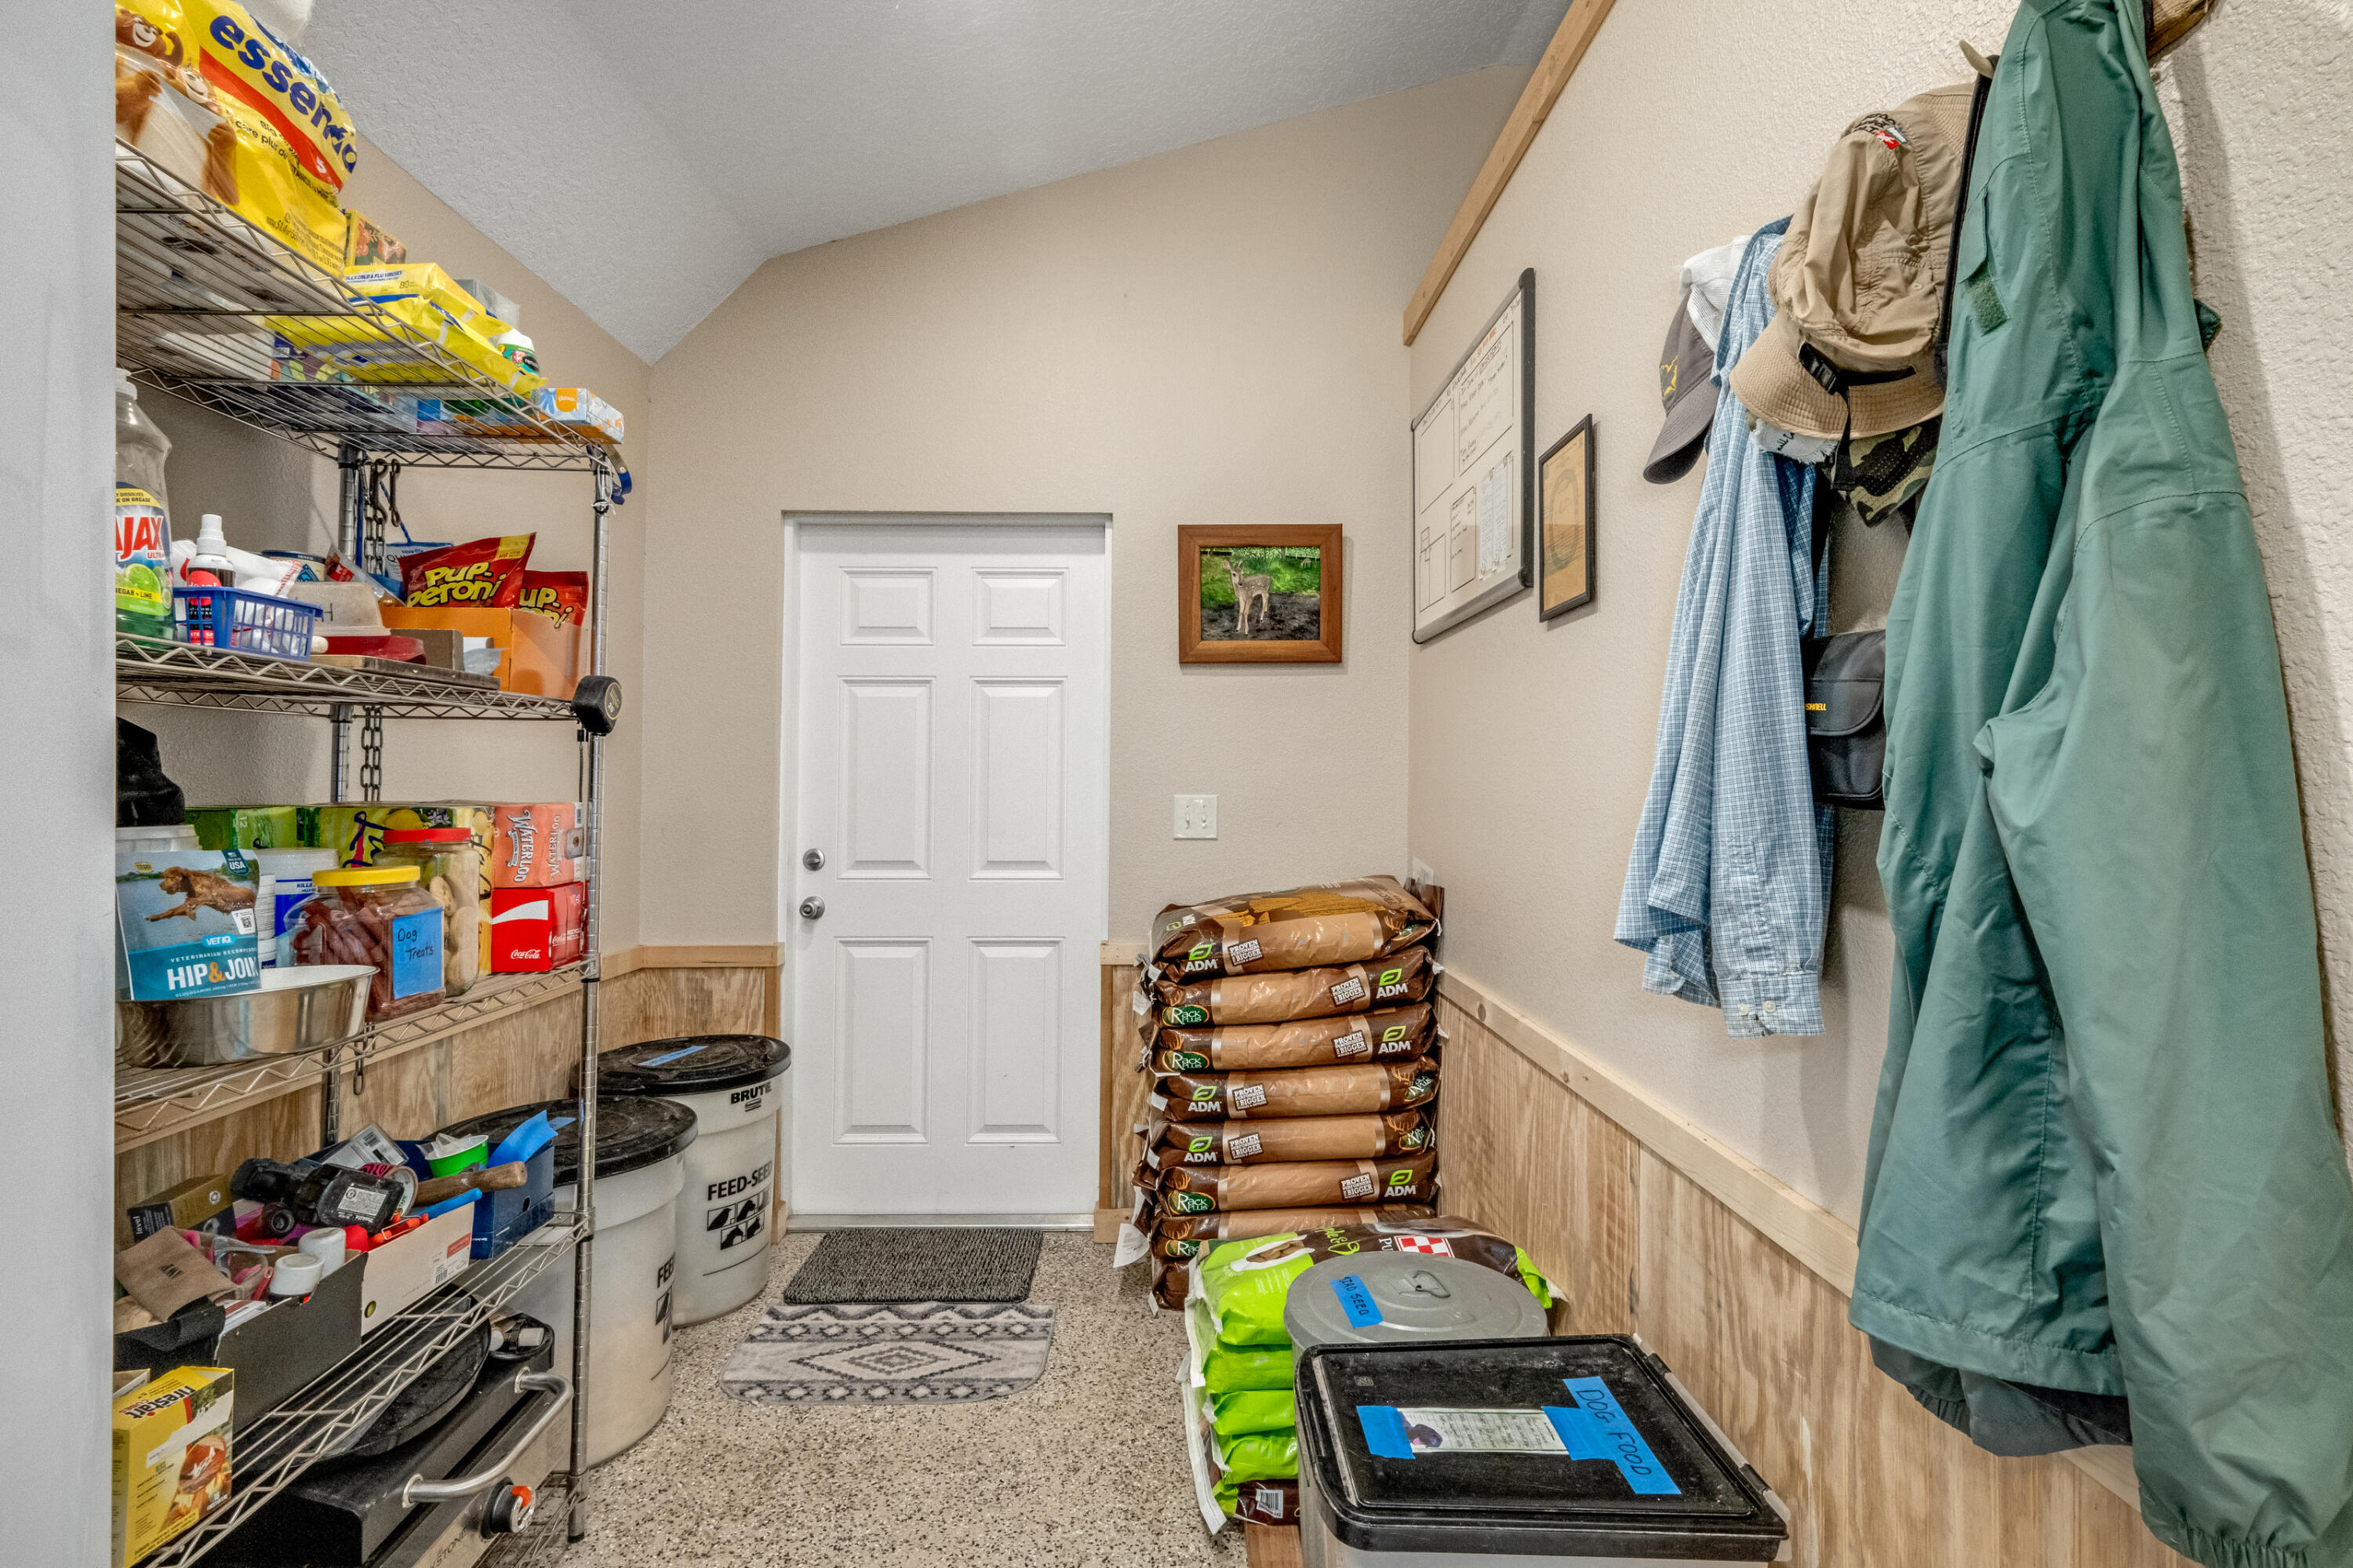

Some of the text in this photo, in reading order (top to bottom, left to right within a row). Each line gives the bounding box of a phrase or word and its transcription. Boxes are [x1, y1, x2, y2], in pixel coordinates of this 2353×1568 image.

[1805, 702, 1827, 711] SHNELL
[508, 809, 538, 883] WATERLOO
[228, 860, 246, 871] USA
[405, 944, 435, 961] Treats
[1229, 939, 1259, 952] PROVEN
[1236, 948, 1262, 962] BIGGER
[1184, 959, 1218, 973] ADM
[166, 963, 209, 991] HIP
[225, 956, 260, 981] JOIN
[1331, 977, 1360, 991] PROVEN
[1376, 983, 1409, 999] ADM
[1338, 988, 1364, 1002] BIGGER
[1333, 1031, 1362, 1045] PROVEN
[1340, 1041, 1366, 1054] BIGGER
[1378, 1040, 1412, 1054] ADM
[730, 1081, 773, 1105] BRUTE
[1234, 1084, 1264, 1097] PROVEN
[1187, 1101, 1221, 1112] ADM
[1239, 1094, 1266, 1107] BIGGER
[1229, 1133, 1259, 1147] PROVEN
[1184, 1151, 1217, 1162] ADM
[1235, 1144, 1262, 1156] BIGGER
[707, 1159, 773, 1202] FEED-SEED
[1340, 1173, 1370, 1188] PROVEN
[1347, 1184, 1373, 1196] BIGGER
[1384, 1185, 1417, 1198] ADM
[132, 1215, 144, 1235] level
[1350, 1294, 1369, 1316] SEED
[1576, 1388, 1653, 1475] DOG FOOD
[431, 1529, 467, 1568] KSTONE
